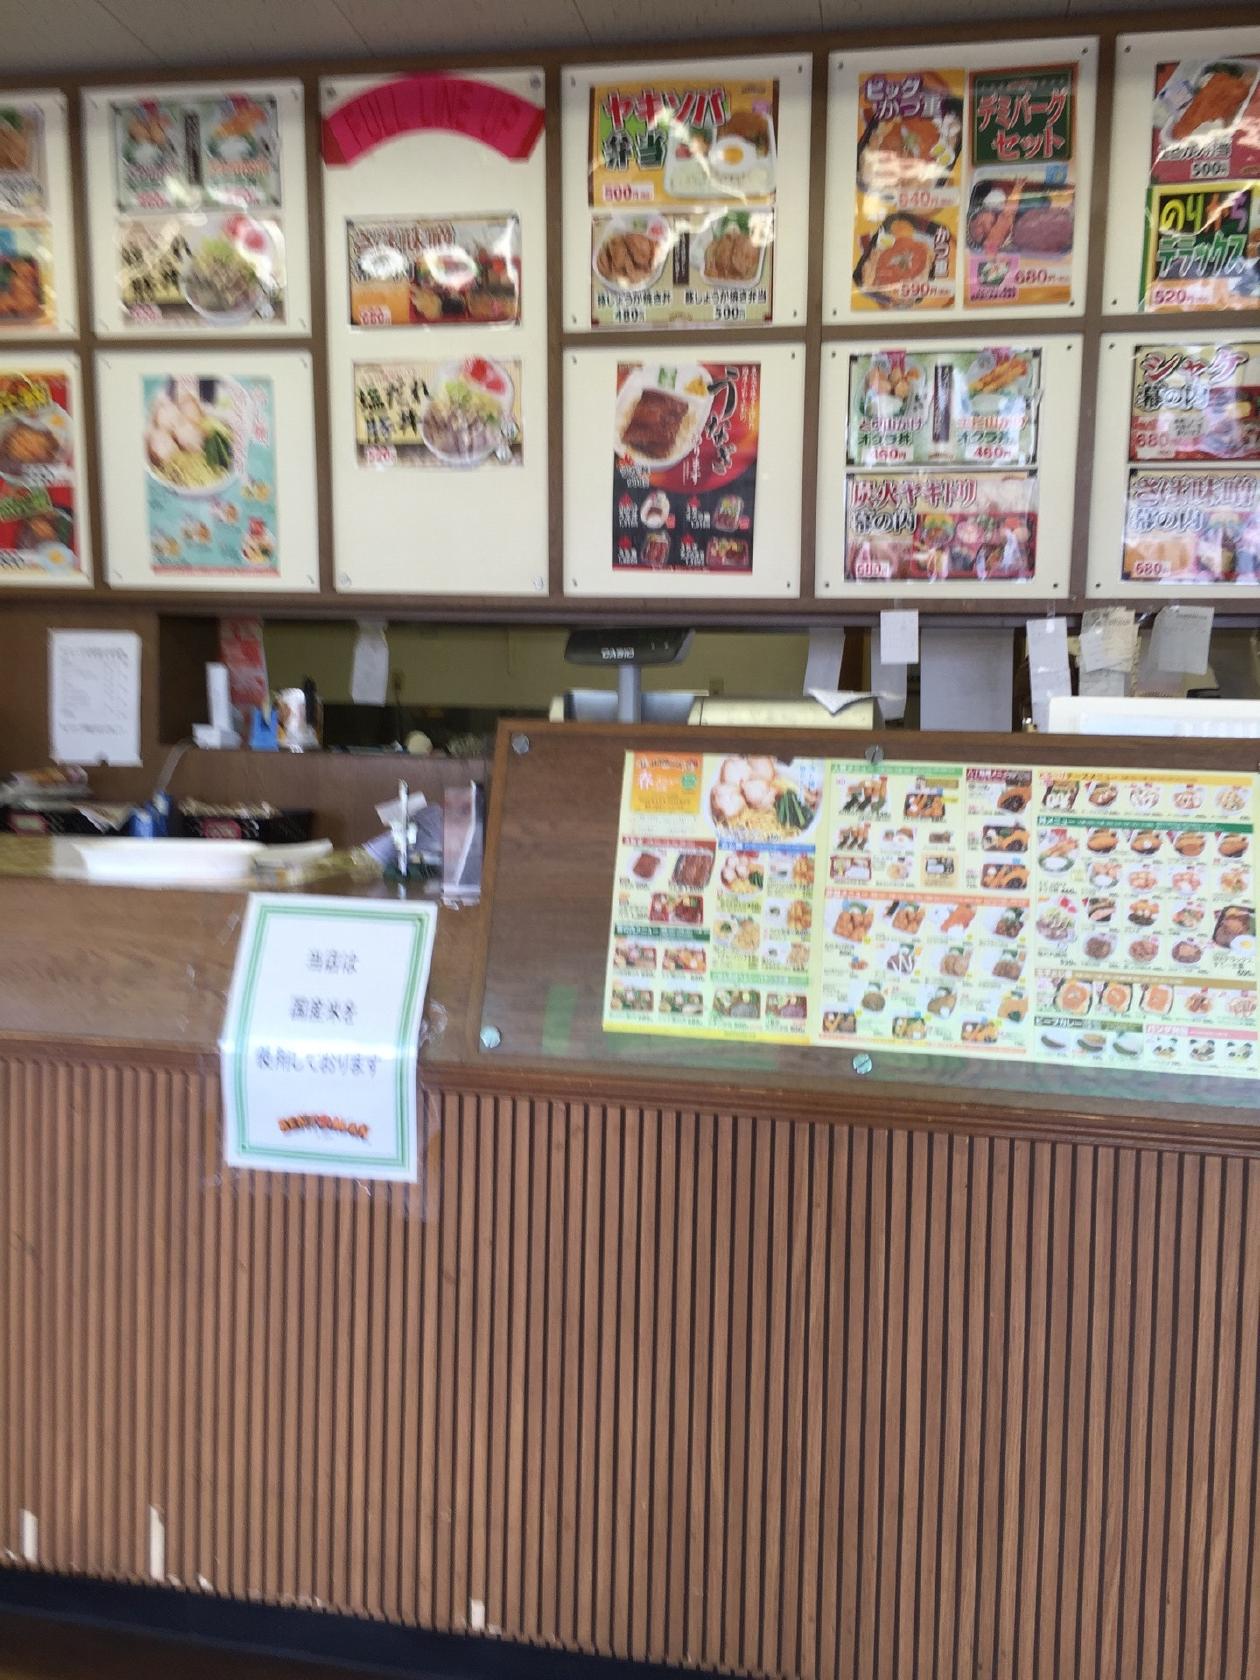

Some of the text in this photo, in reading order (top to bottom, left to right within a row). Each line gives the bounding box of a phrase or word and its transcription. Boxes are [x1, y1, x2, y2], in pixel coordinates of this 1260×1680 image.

[978, 88, 1069, 131] デミバーグ
[992, 126, 1065, 160] セット
[602, 647, 635, 660] CASIO
